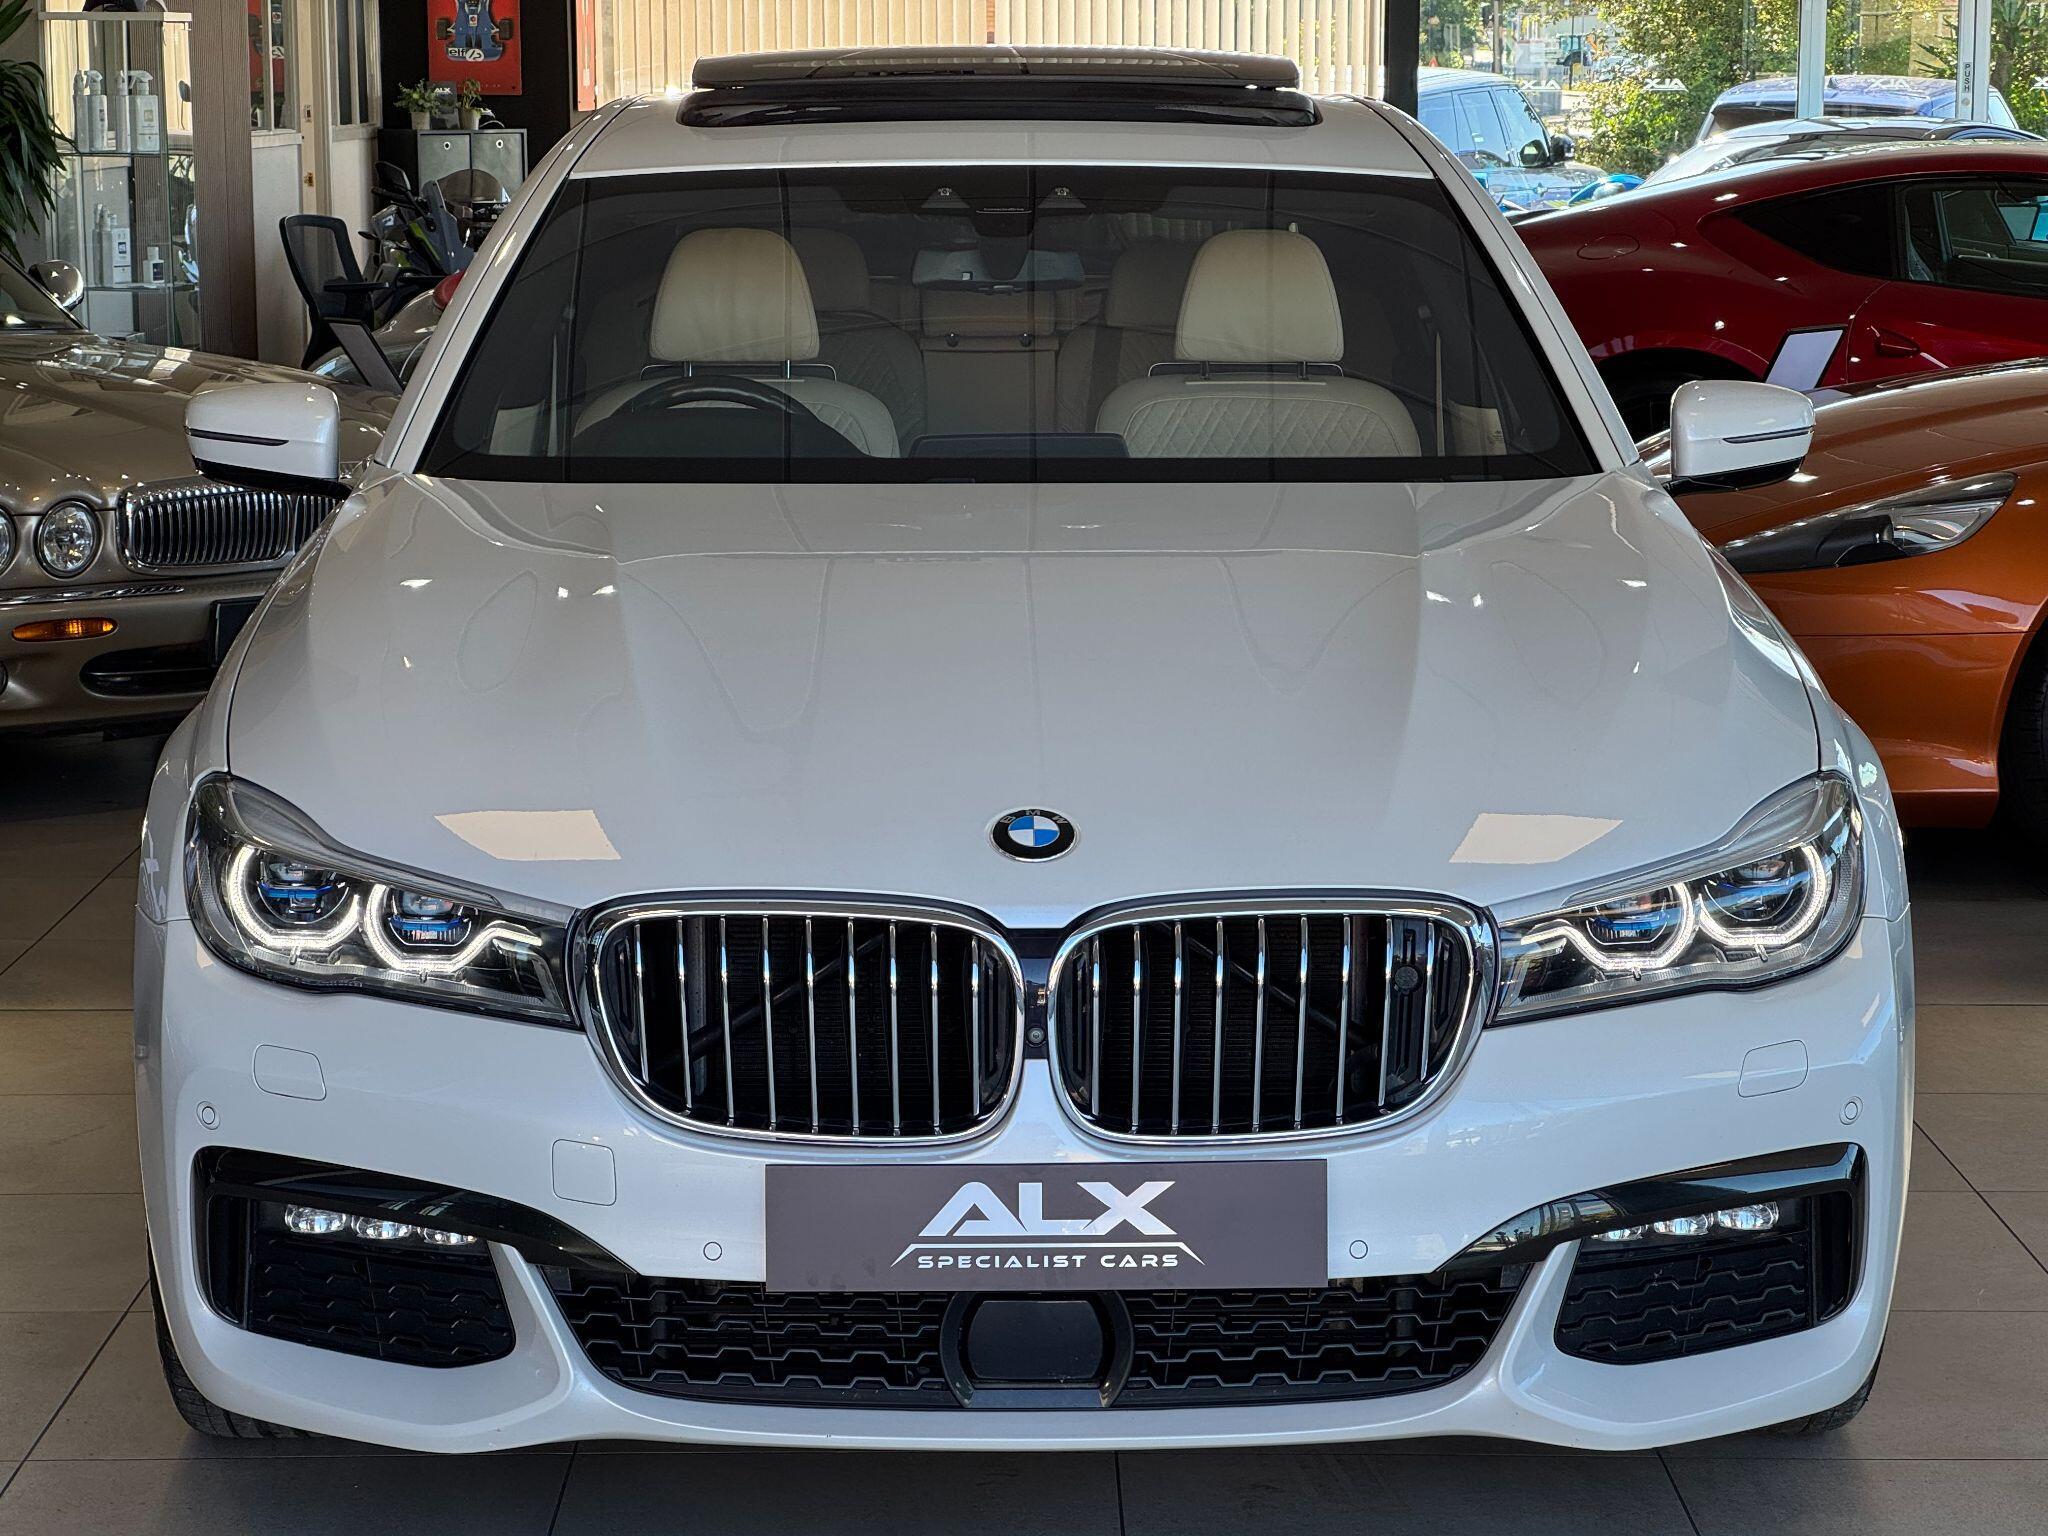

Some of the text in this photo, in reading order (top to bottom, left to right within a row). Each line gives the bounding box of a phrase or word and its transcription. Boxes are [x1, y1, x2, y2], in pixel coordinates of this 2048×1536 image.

[448, 47, 466, 57] elf
[918, 1181, 1178, 1237] ALX
[917, 1254, 1179, 1269] SPECIALIST CARS
